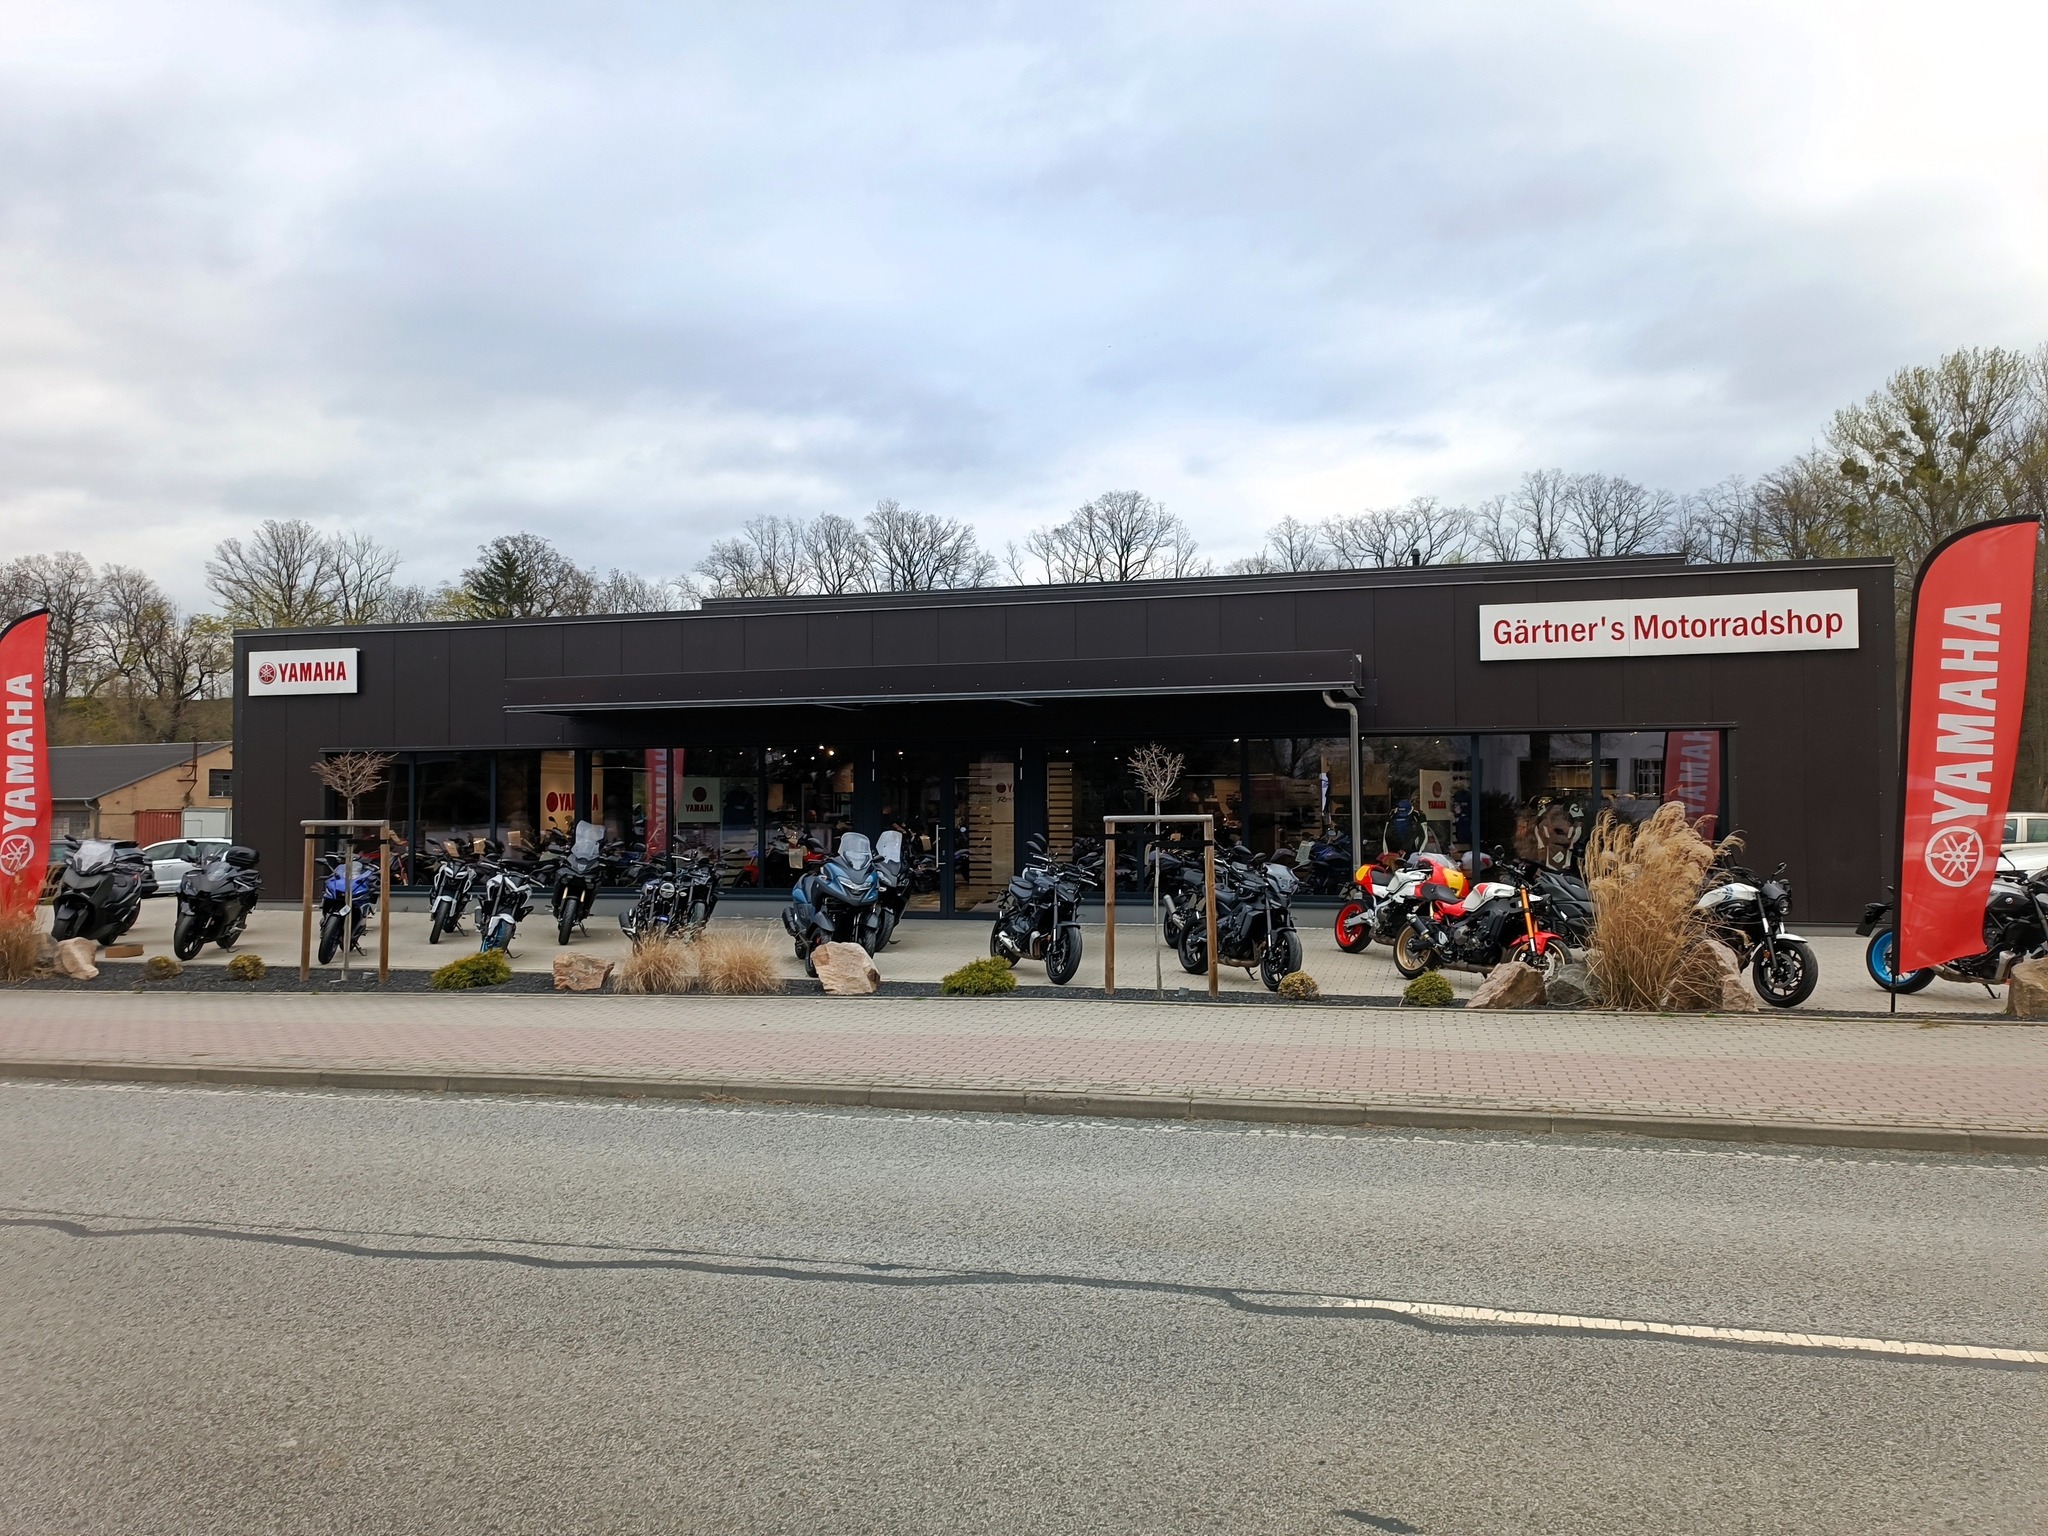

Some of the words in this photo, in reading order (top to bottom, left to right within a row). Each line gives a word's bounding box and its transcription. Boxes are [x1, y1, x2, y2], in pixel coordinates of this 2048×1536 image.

[1493, 616, 1625, 645] Gärtner's
[1633, 608, 1843, 641] Motorradshop
[279, 660, 347, 683] YAMAHA
[1931, 602, 2002, 824] YAMAHA
[2, 673, 37, 835] YAMAHA
[685, 804, 714, 813] YAMAHA
